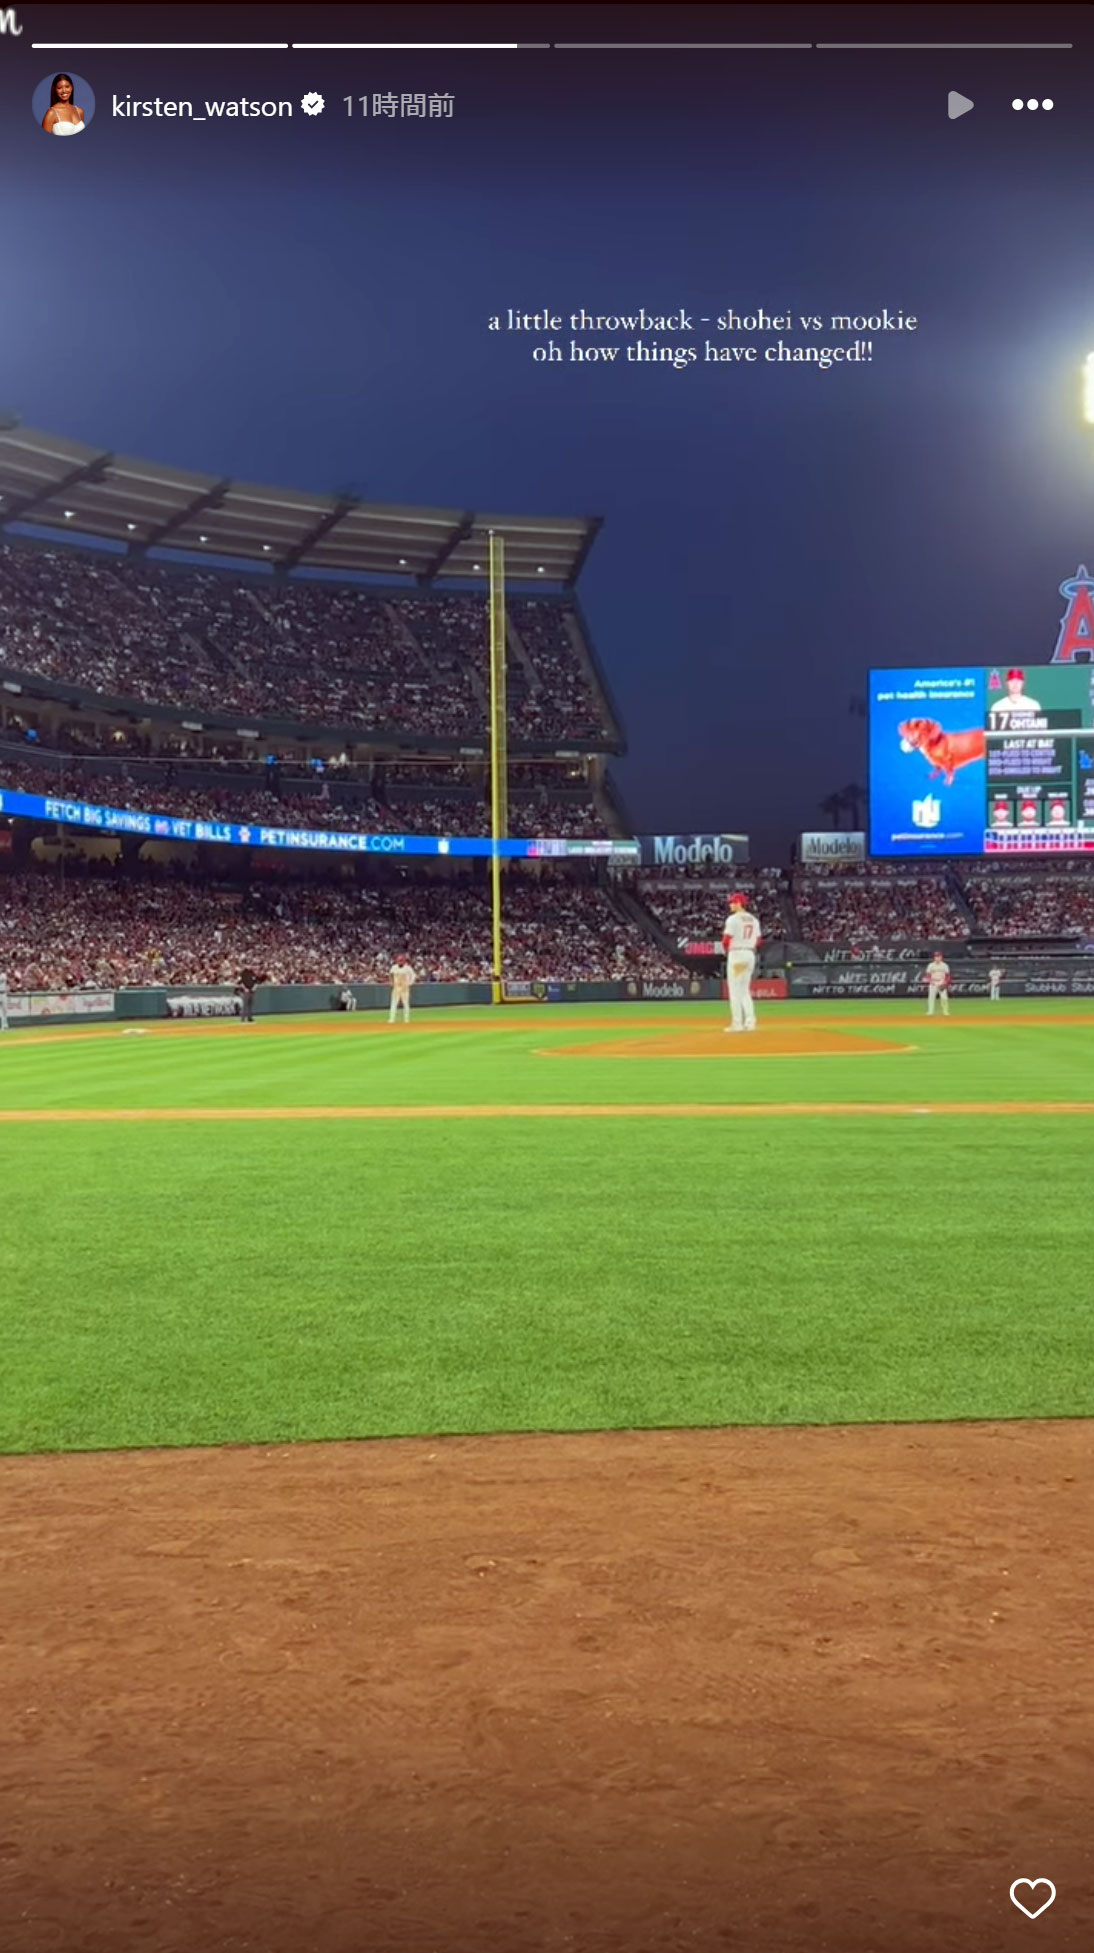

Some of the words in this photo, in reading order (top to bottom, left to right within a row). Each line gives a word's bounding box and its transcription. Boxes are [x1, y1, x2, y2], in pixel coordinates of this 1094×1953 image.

[877, 692, 895, 702] pet
[896, 690, 927, 700] health
[929, 690, 975, 699] insurance
[989, 712, 1010, 730] 17
[1010, 717, 1048, 730] OHTANI
[1003, 738, 1025, 750] LAST
[44, 800, 81, 820] FETCH
[83, 807, 103, 825] BIG
[104, 810, 152, 832] SAVINGS
[172, 821, 193, 836] VET
[194, 823, 233, 841] BILLS
[653, 834, 733, 864] Modelo
[807, 836, 862, 855] Modelo
[642, 982, 684, 997] Modelo
[1071, 982, 1094, 993] Stub
